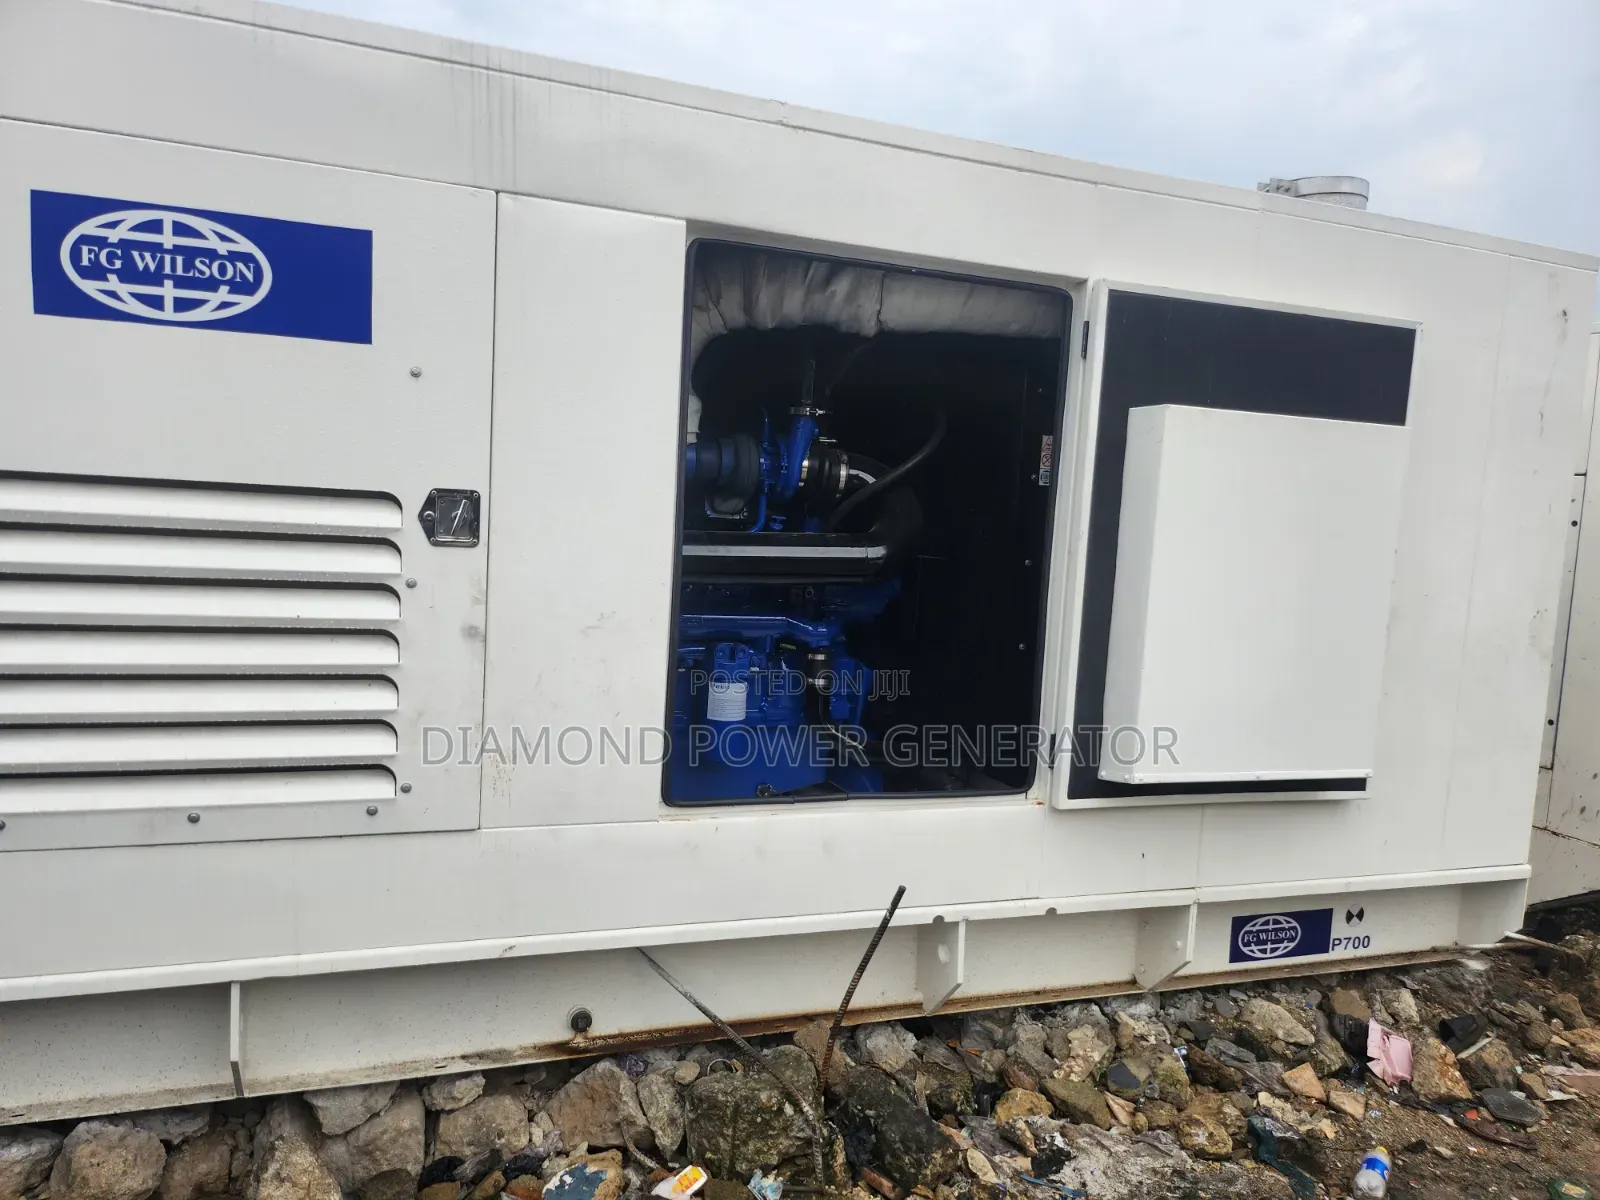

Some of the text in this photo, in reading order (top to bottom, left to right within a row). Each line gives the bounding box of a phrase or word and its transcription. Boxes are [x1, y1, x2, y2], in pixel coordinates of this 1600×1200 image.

[79, 244, 256, 283] FG WILSON
[1243, 929, 1297, 943] FG WILSON
[1331, 935, 1371, 952] P700
